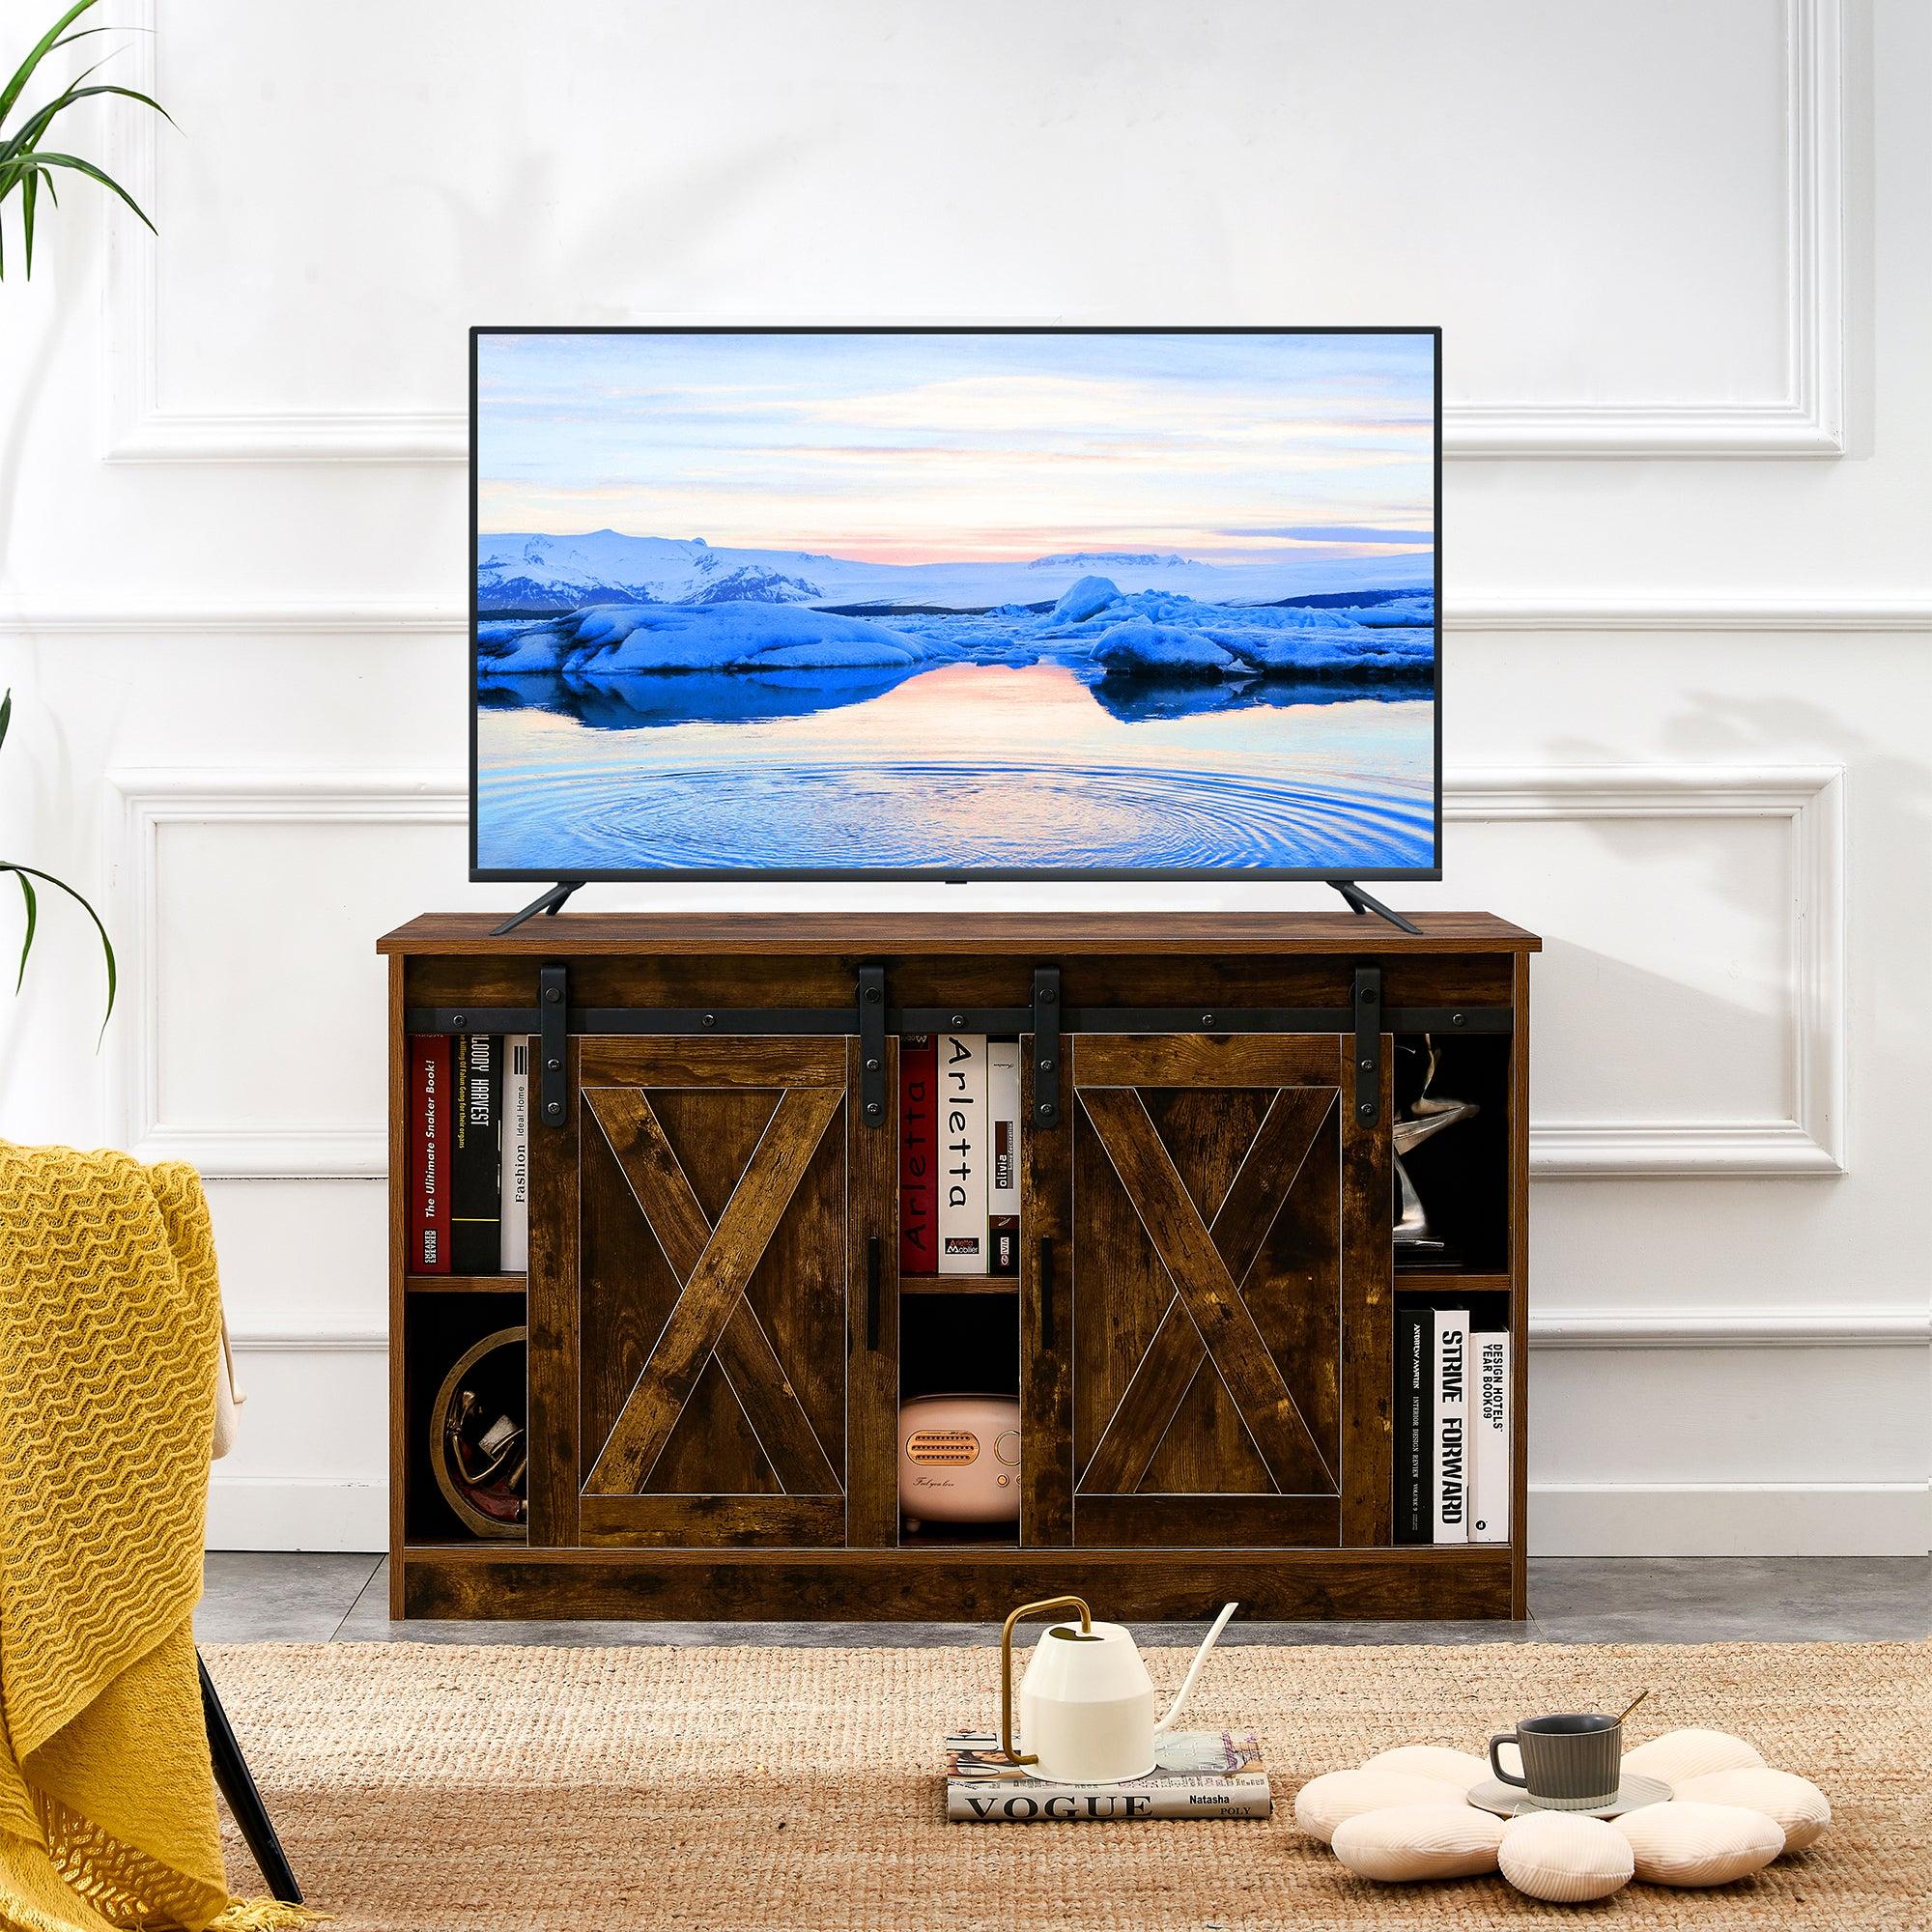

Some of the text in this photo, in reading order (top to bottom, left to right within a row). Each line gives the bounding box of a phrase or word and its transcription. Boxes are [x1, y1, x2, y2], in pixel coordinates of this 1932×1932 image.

[425, 1060, 435, 1094] Book!
[470, 1035, 490, 1127] LOODY HARVEST
[424, 1097, 435, 1139] Snaker
[516, 1086, 525, 1137] Ideal Home
[949, 1036, 975, 1208] Arletta
[515, 1145, 526, 1204] Fashion
[903, 1081, 926, 1252] Arletta
[996, 1154, 1008, 1187] olivia
[425, 1198, 436, 1218] The
[1482, 1344, 1493, 1373] YEAR
[1492, 1344, 1503, 1383] DESIGN
[1442, 1330, 1463, 1524] STRIVE FORWARD
[965, 1796, 1153, 1819] VOGUE
[1189, 1794, 1231, 1804] Natasha
[1220, 1806, 1251, 1816] POLY
